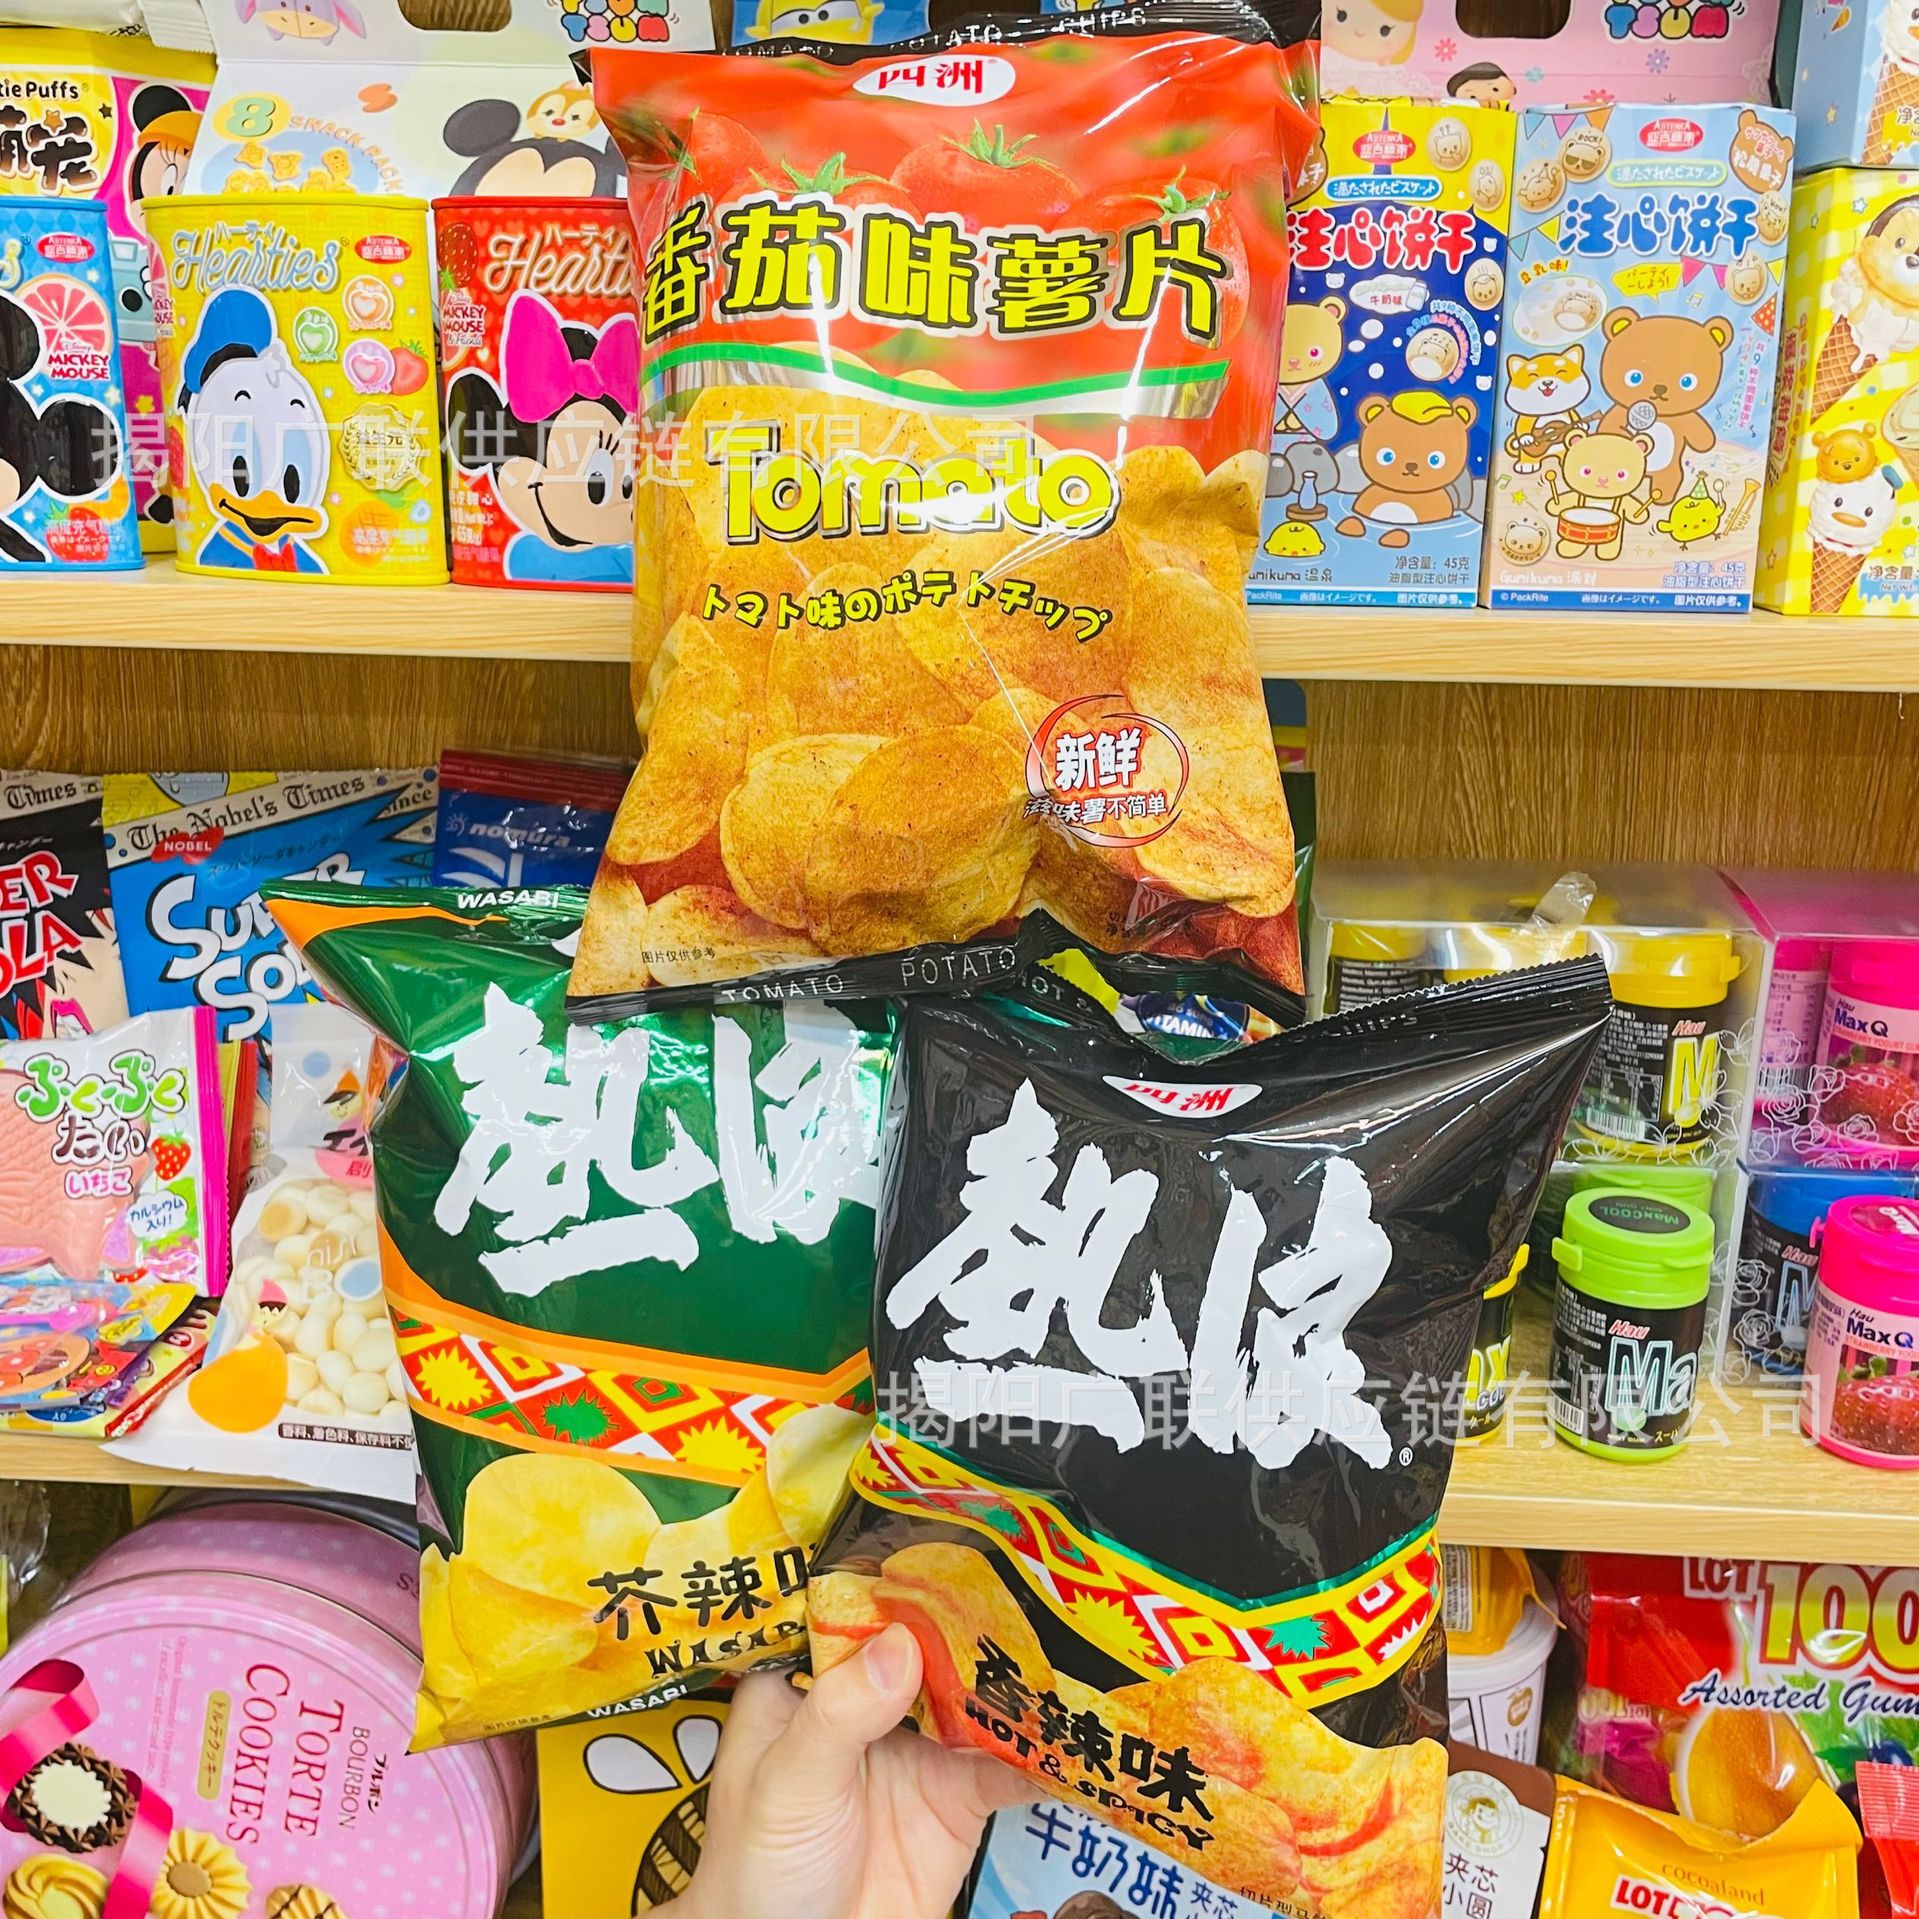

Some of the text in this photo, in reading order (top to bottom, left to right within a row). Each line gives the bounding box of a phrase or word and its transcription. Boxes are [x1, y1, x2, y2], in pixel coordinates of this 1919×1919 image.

[26, 80, 79, 100] Puffs
[878, 59, 984, 94] 四洲
[222, 96, 278, 138] 8
[1558, 193, 1759, 258] 注心饼干
[172, 231, 341, 293] Hearties
[644, 197, 1234, 345] 番茄味薯片
[443, 307, 485, 320] MICKEY
[443, 320, 485, 333] MOUSE
[47, 353, 110, 367] MICKEY
[51, 366, 109, 379] MOUSE
[704, 420, 1121, 545] Tomato
[1304, 567, 1333, 582] 温泉
[701, 569, 1114, 643] トマト味のポテトチップ
[1510, 592, 1549, 602] PackRite
[1055, 726, 1143, 792] 新鲜
[3, 782, 77, 810] Times
[127, 824, 180, 851] The
[186, 796, 279, 836] Nobel's
[282, 774, 366, 810] Times
[1024, 792, 1168, 826] 滋味薯不简单
[163, 839, 213, 852] NOBEL
[469, 822, 571, 848] nomura
[457, 889, 560, 910] WASABI
[641, 947, 716, 964] 图片仅供参考
[721, 946, 1016, 1001] TOMATO POTATO
[1834, 1007, 1889, 1038] Max Q
[14, 1048, 186, 1124] ぷくぷく
[1122, 1082, 1235, 1112] 四洲
[51, 1113, 147, 1166] たい
[129, 1197, 186, 1223] カルシウム
[1608, 1319, 1650, 1341] Hau
[1846, 1317, 1915, 1350] Max Q
[1850, 1308, 1875, 1324] Hau
[586, 1683, 688, 1719] WASABI
[1681, 1667, 1827, 1712] Assorted
[206, 1700, 221, 1790] トルテクッキー
[974, 1633, 1216, 1823] 香辣味
[226, 1662, 291, 1844] COOKIES
[284, 1699, 345, 1838] TORTE
[338, 1725, 371, 1830] BOURBON
[369, 1752, 388, 1815] ブルボン
[964, 1695, 1216, 1851] HOT & SPICY
[1025, 1802, 1185, 1919] 牛奶味
[1445, 1852, 1499, 1894] 夹芯
[1190, 1880, 1239, 1919] 夹芯
[1615, 1878, 1670, 1916] LOT
[1662, 1864, 1765, 1907] cocoaland
